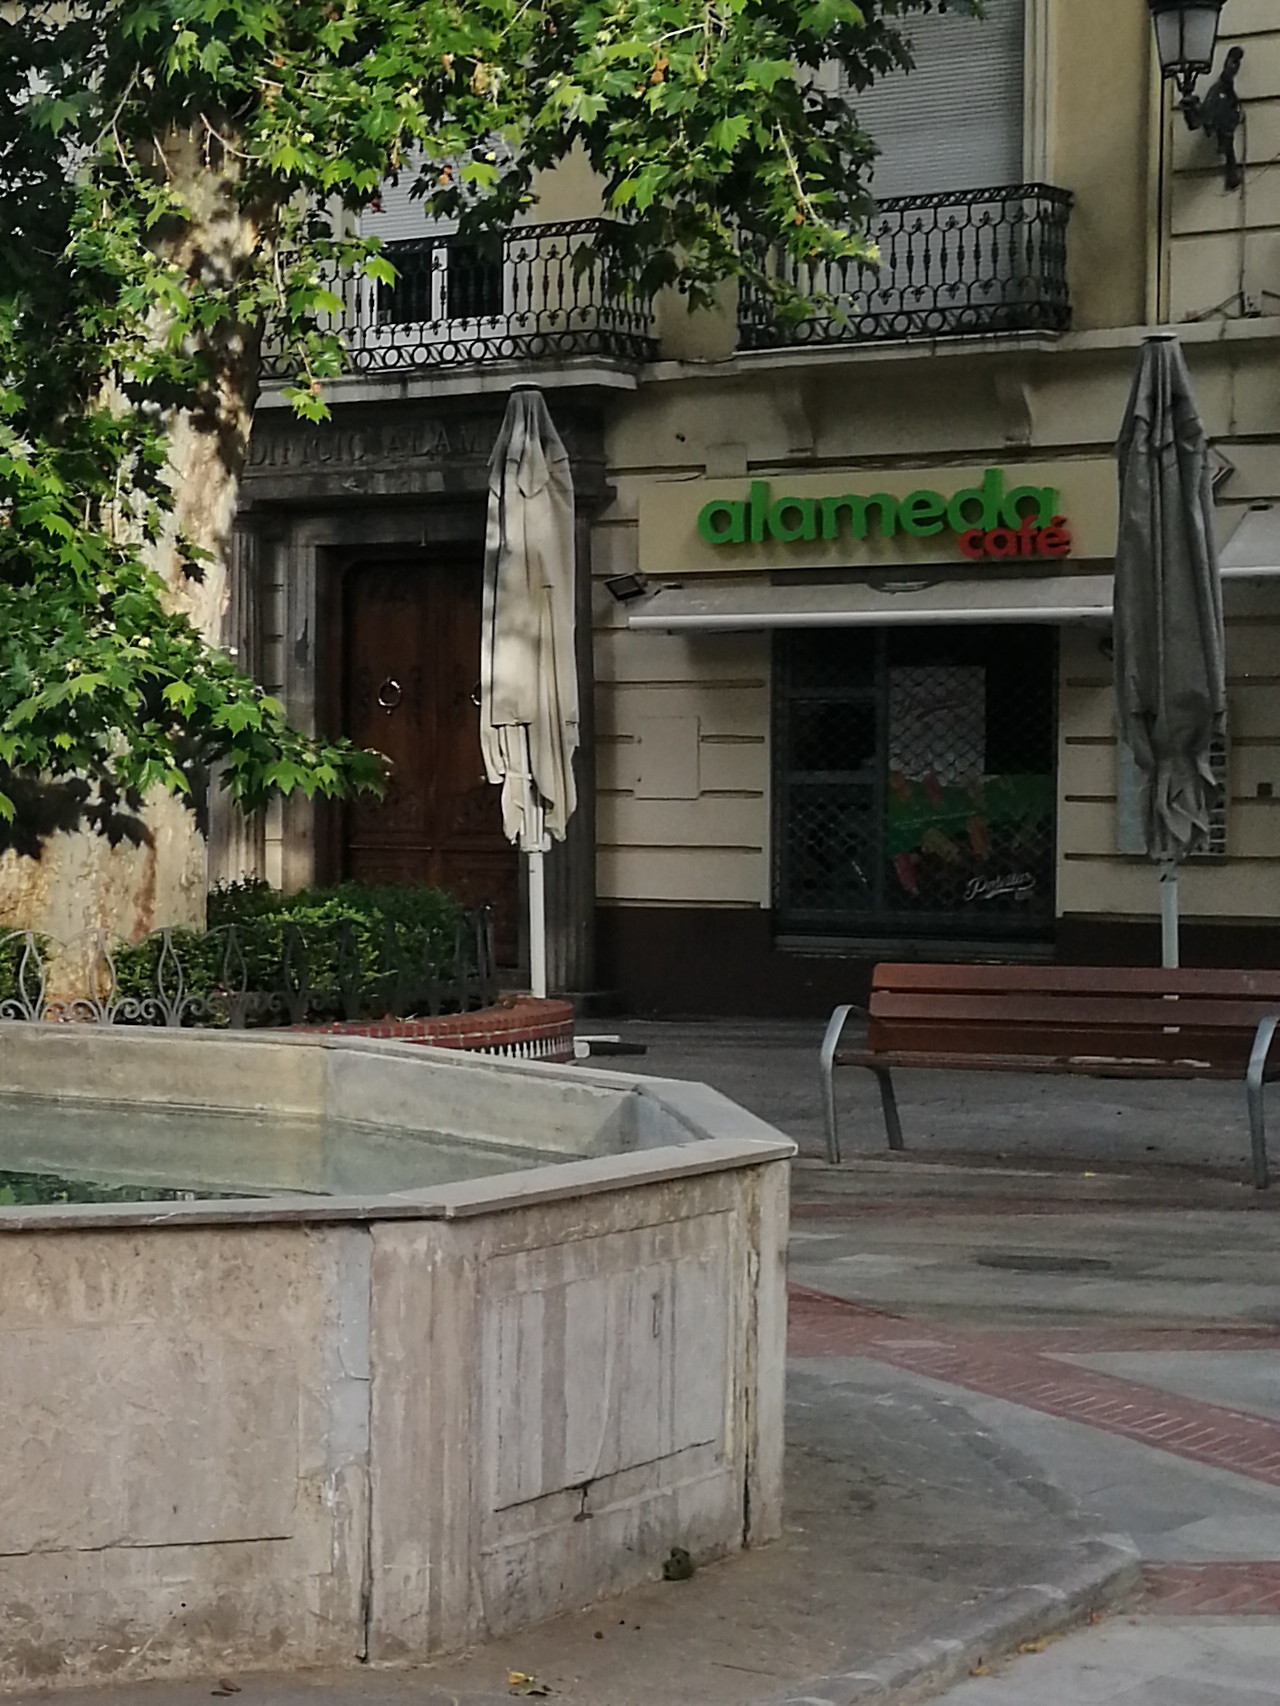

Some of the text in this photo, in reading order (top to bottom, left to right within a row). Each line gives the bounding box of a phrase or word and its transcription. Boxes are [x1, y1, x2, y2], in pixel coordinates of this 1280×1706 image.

[243, 431, 370, 466] DIFICIO
[697, 468, 1060, 545] alameda
[958, 515, 1073, 559] café
